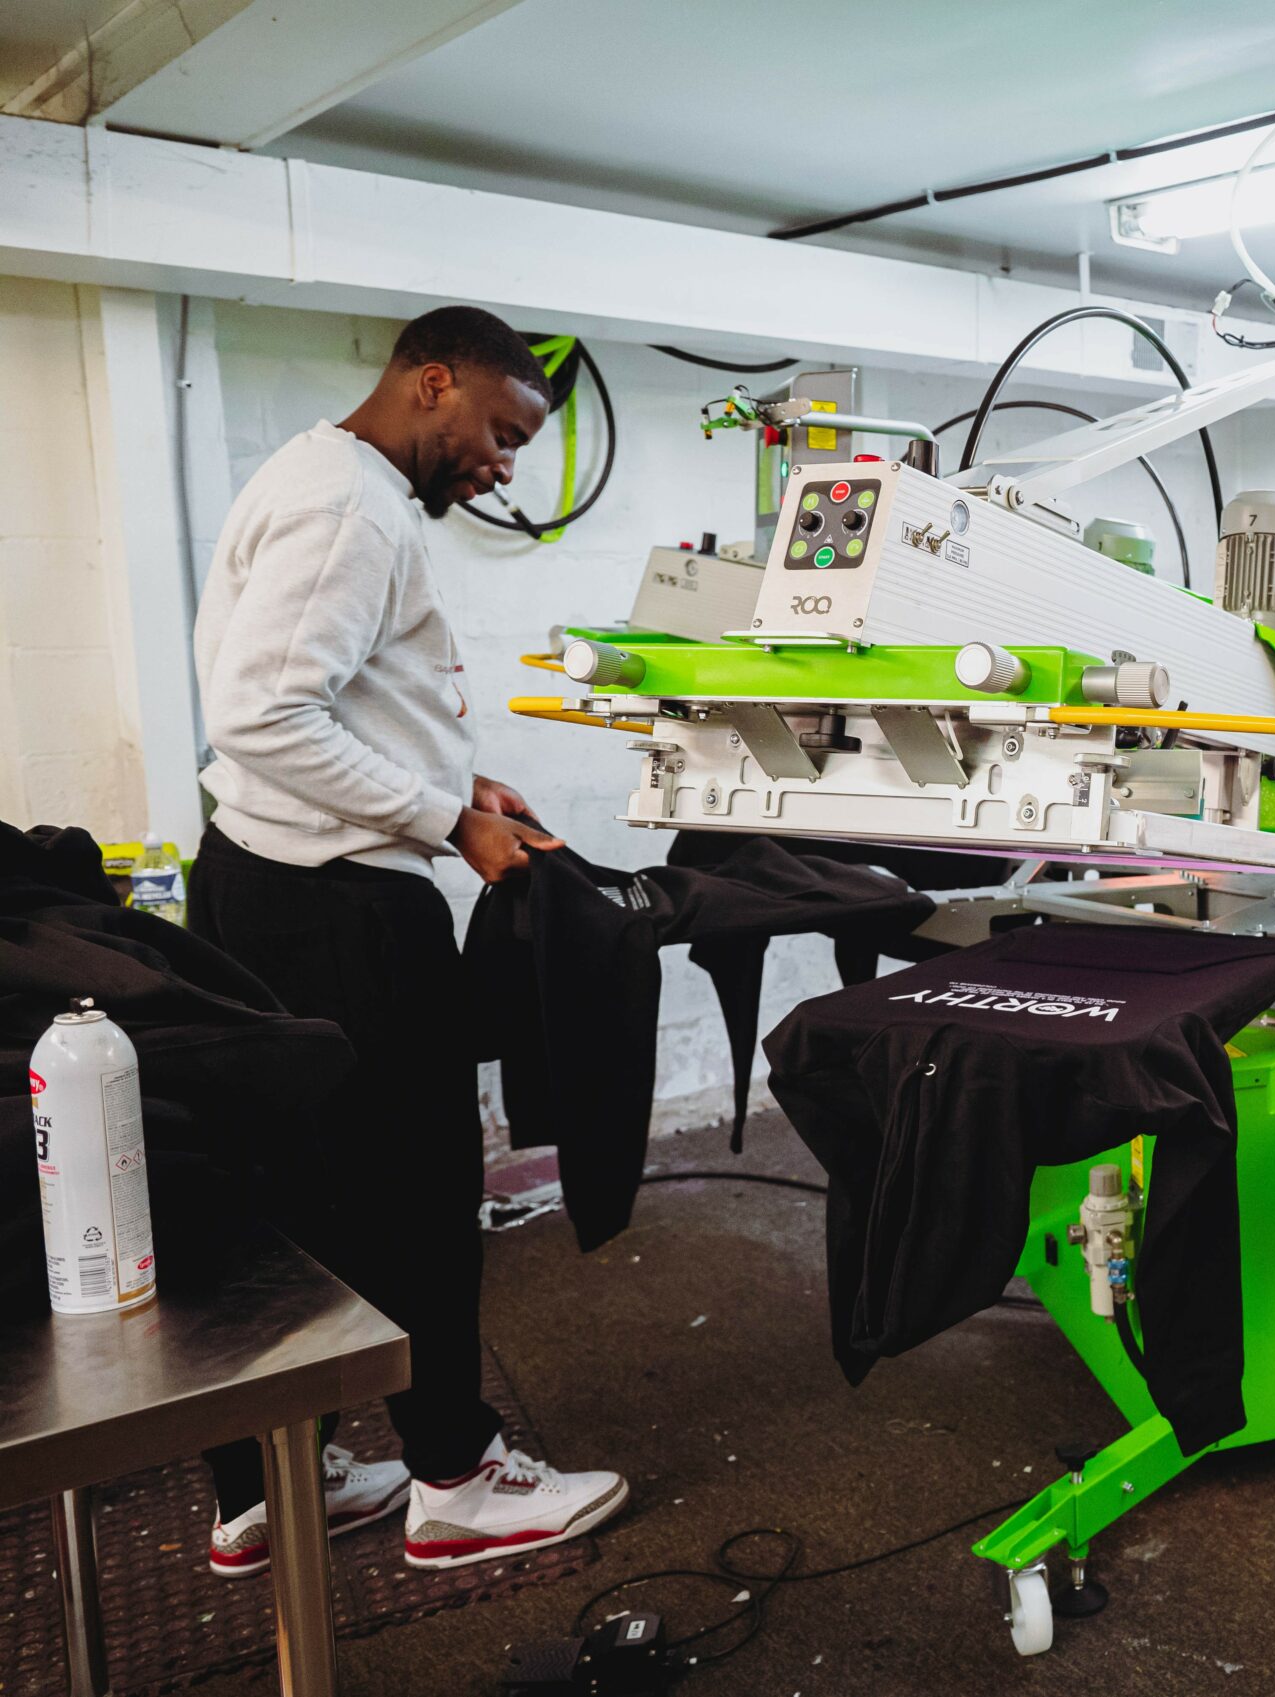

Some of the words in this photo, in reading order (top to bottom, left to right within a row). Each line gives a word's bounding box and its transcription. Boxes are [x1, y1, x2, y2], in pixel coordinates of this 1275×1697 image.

[1249, 514, 1258, 527] 7
[790, 595, 833, 615] ROQ
[889, 989, 1119, 1022] WORTHY
